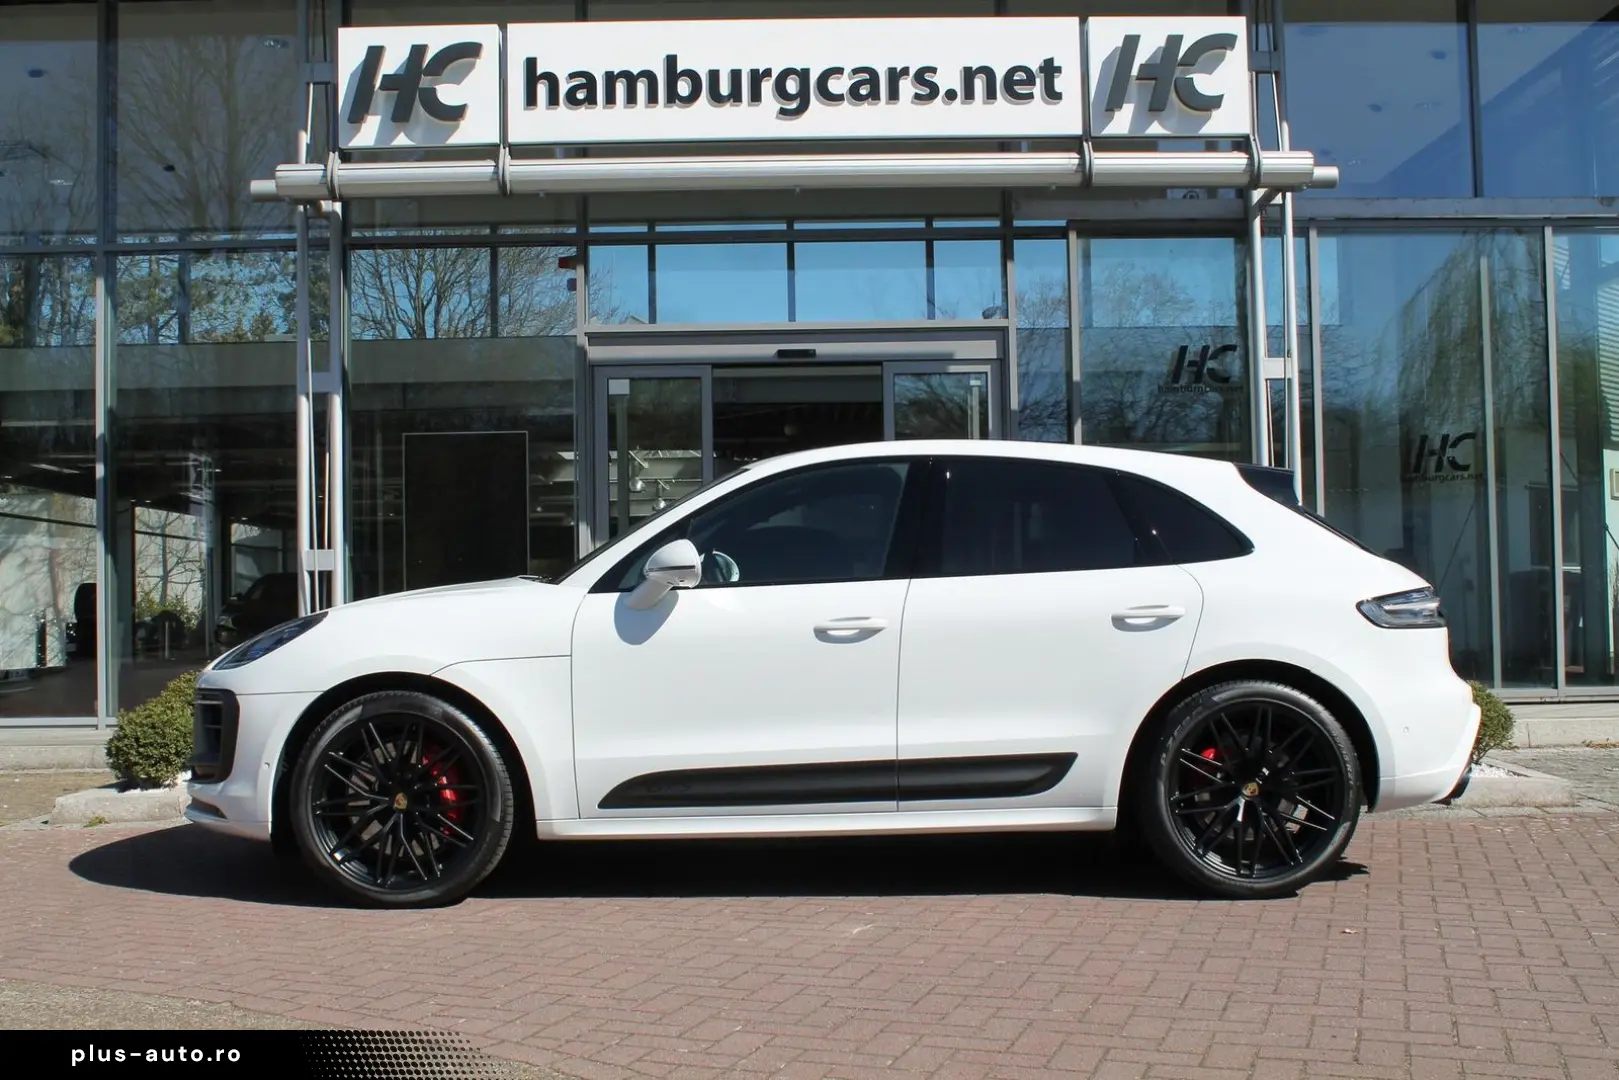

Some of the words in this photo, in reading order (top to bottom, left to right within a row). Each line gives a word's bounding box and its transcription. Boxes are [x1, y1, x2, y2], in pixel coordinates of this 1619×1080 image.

[347, 41, 483, 124] HC
[524, 54, 1063, 118] hamburgcars.net
[1104, 33, 1238, 112] HC
[1171, 344, 1238, 384] HC
[1413, 432, 1477, 473] HC
